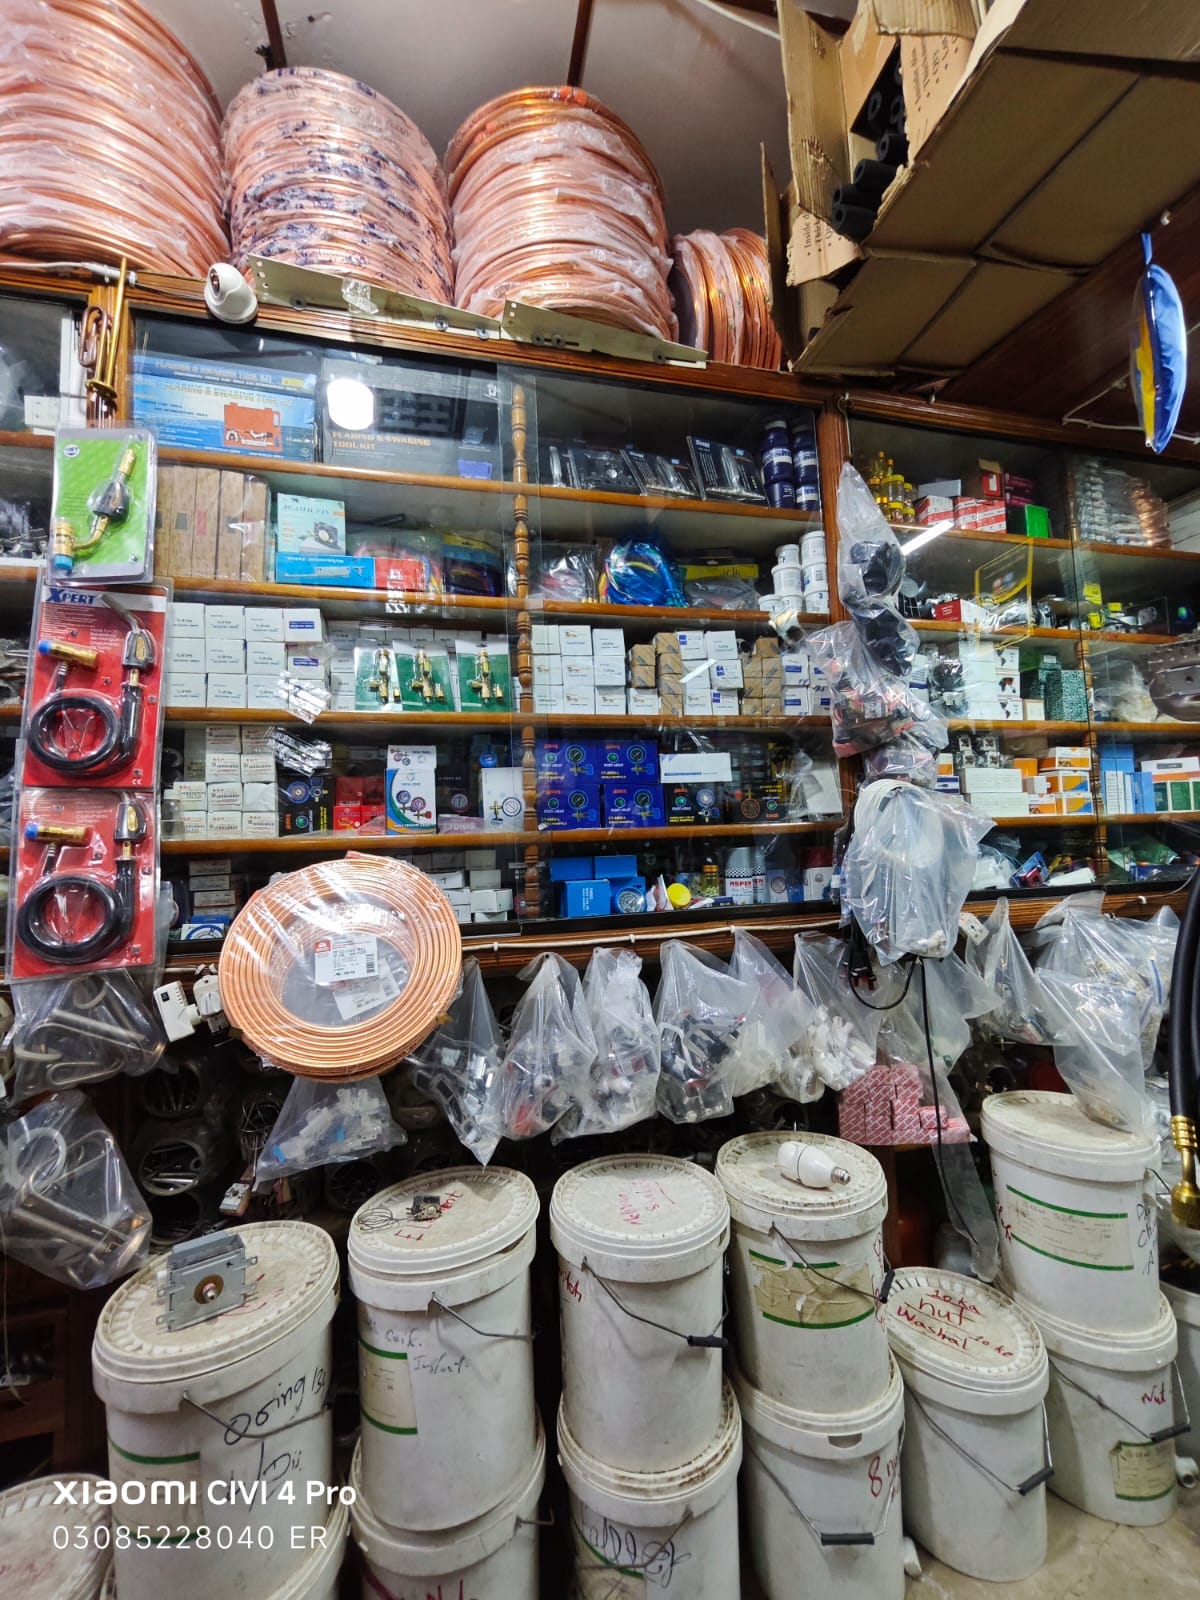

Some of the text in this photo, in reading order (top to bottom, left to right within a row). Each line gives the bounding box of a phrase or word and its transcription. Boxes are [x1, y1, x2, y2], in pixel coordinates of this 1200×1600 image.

[802, 223, 812, 248] Inside
[333, 440, 376, 450] TOOL KIT
[46, 588, 97, 605] XPERT
[1141, 1382, 1167, 1405] Nut
